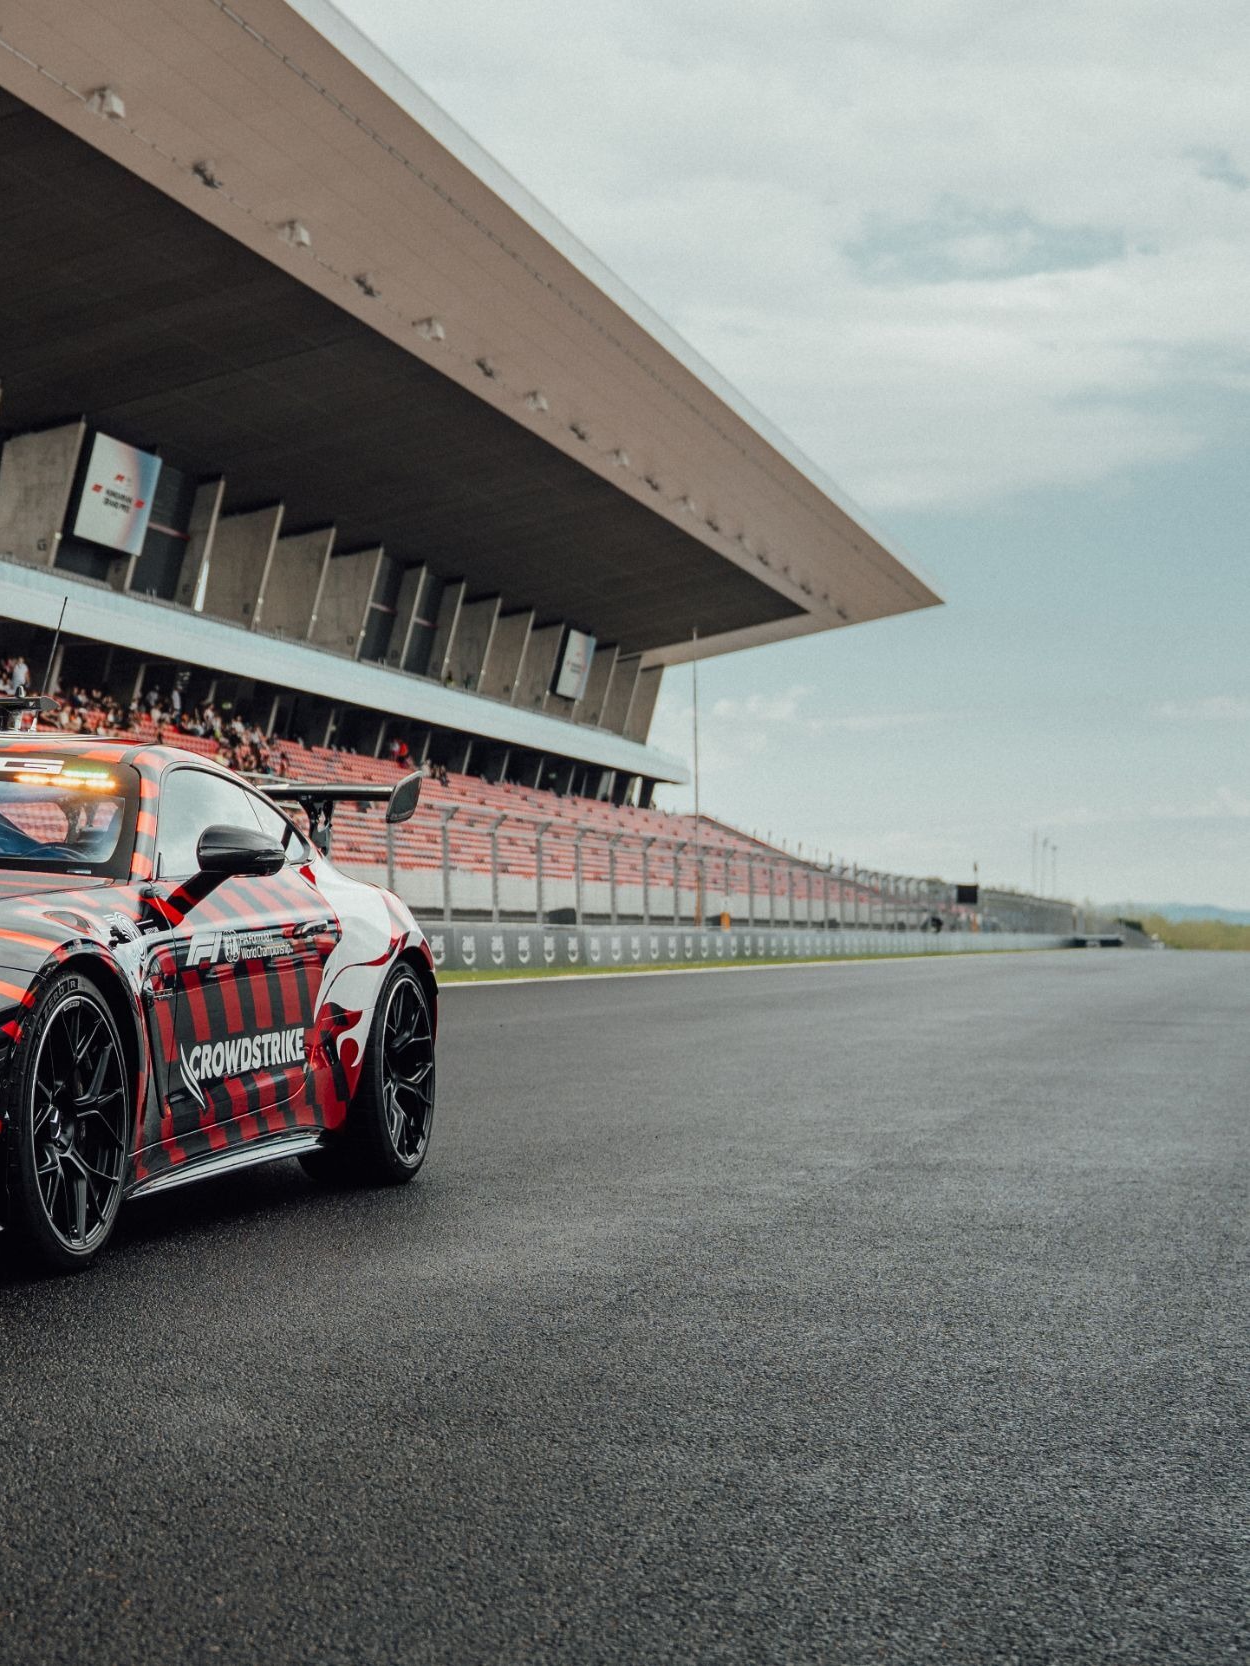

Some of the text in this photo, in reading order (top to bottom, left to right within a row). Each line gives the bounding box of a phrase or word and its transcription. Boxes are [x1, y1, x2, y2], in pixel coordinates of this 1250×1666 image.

[185, 932, 223, 967] F1
[241, 946, 257, 960] World
[189, 1028, 305, 1080] CROWDSTRIKE
